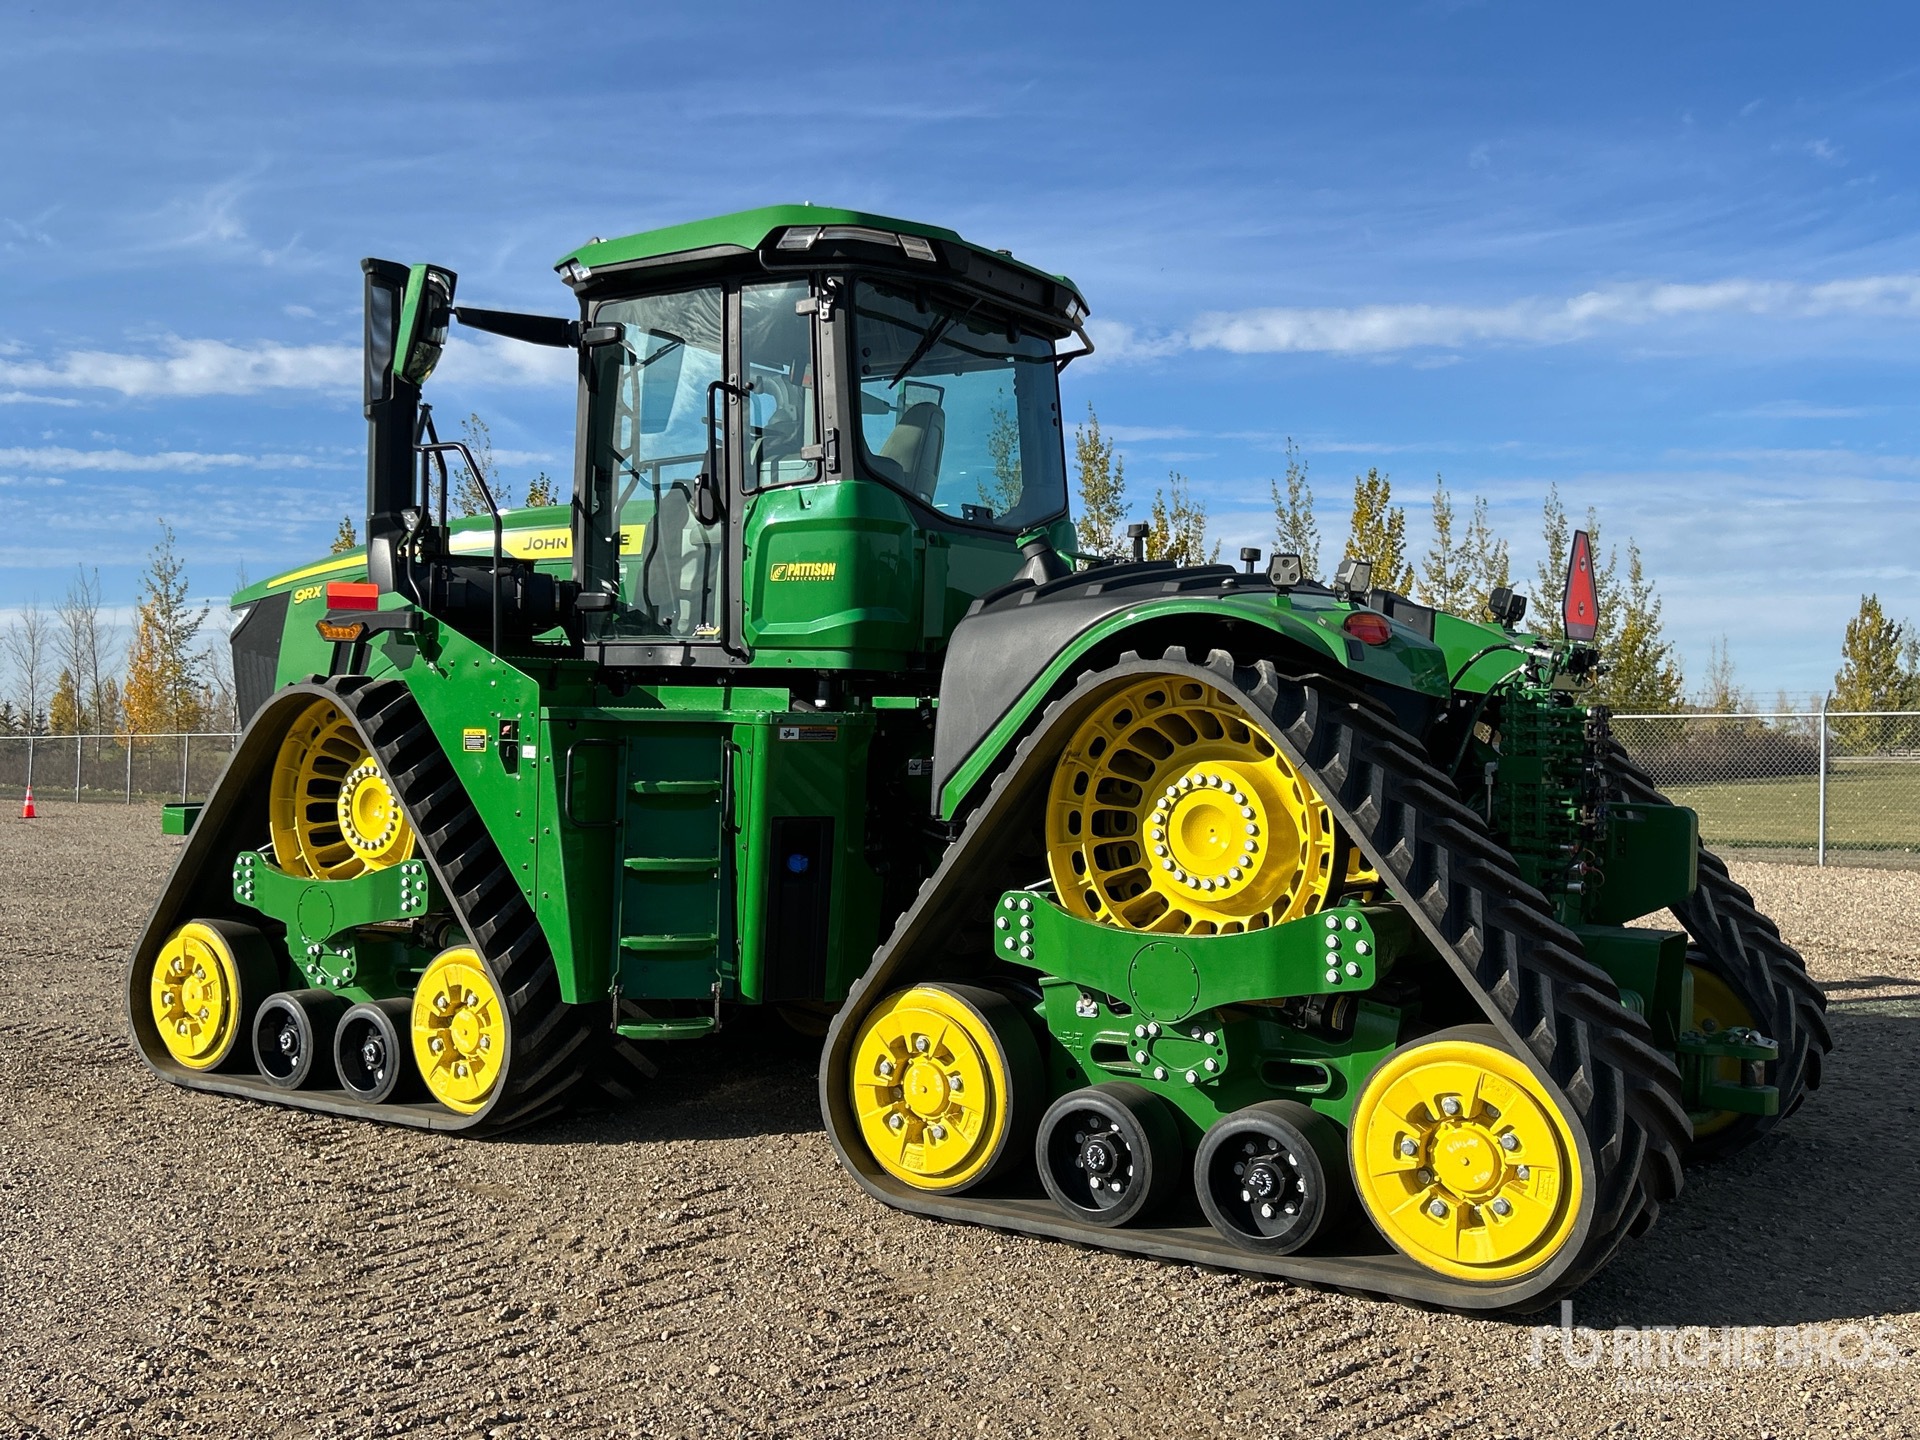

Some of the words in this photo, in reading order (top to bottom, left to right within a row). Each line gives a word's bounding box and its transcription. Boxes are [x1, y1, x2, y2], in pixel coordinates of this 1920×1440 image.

[523, 537, 568, 551] JOHN
[787, 562, 836, 576] PATTISON
[293, 585, 323, 604] 9RX
